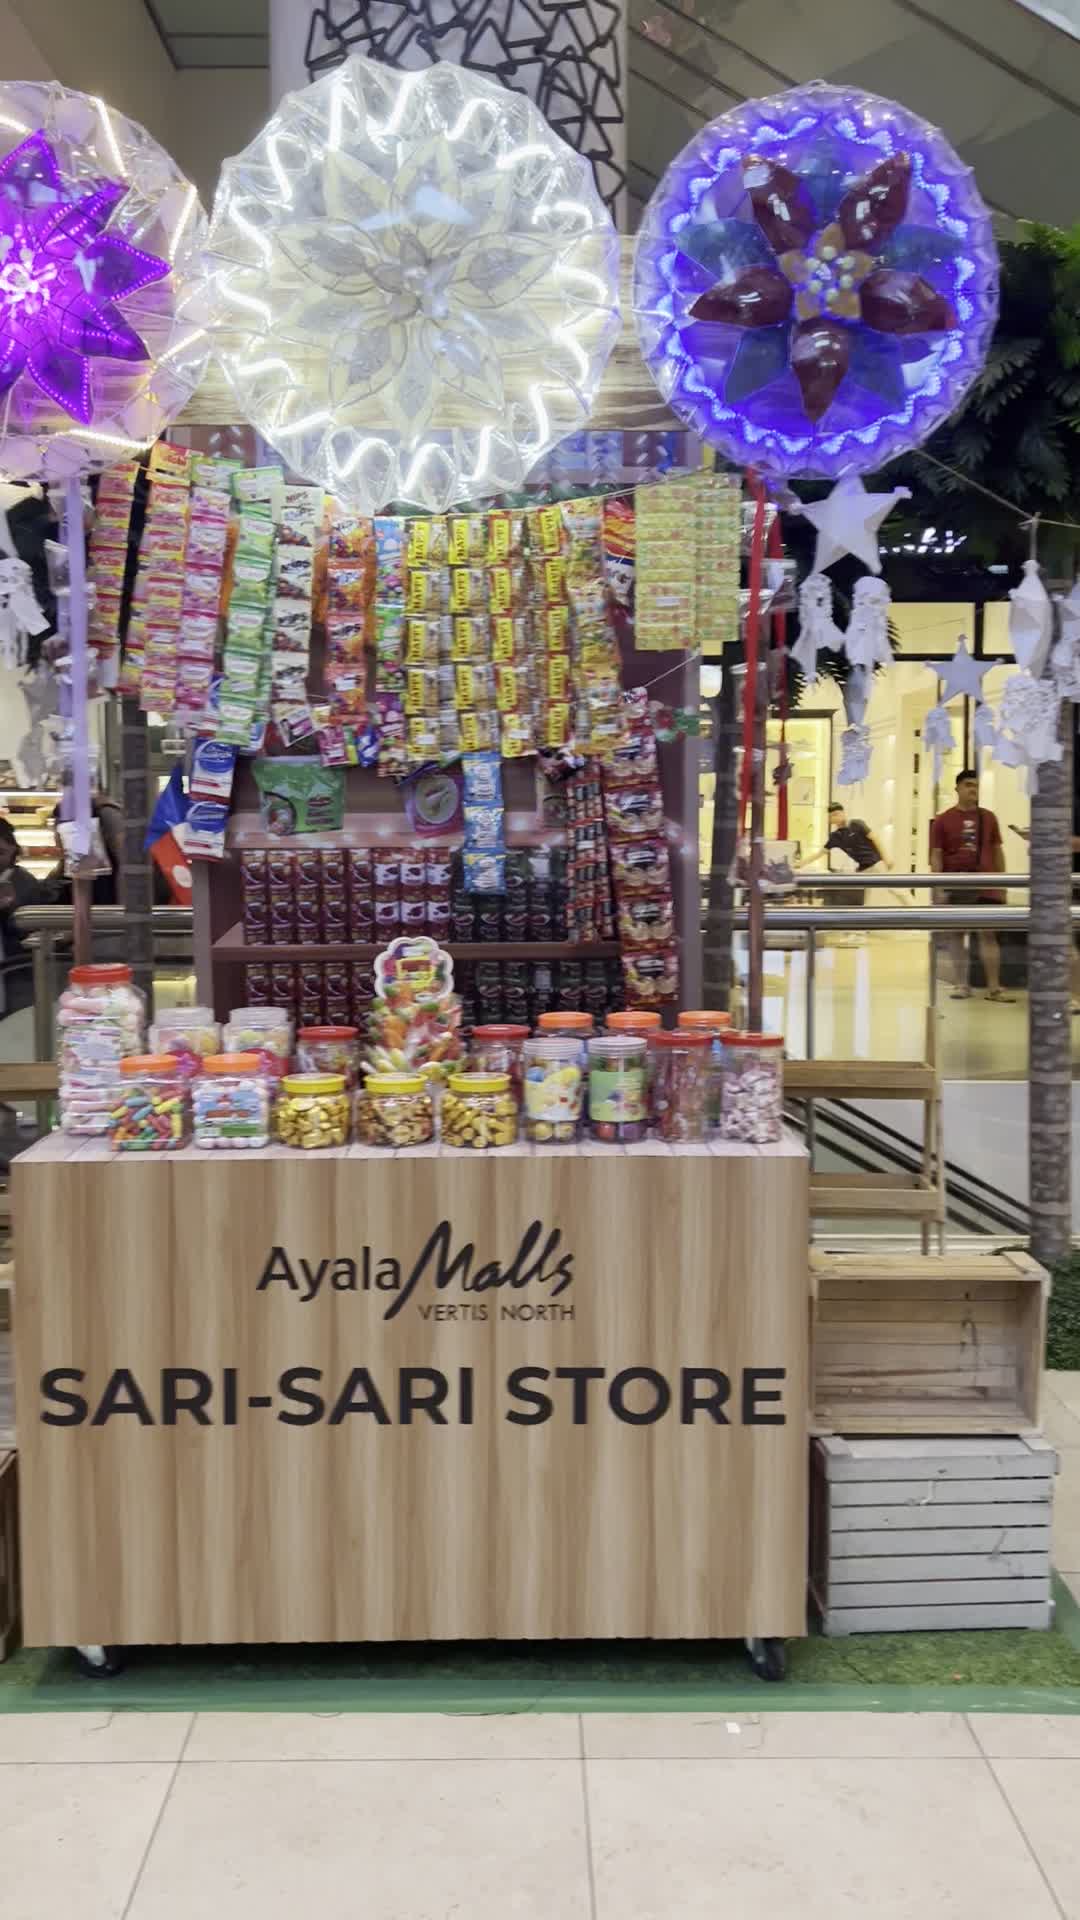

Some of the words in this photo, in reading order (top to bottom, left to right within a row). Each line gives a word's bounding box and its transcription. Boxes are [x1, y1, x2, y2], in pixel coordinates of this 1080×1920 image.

[456, 571, 466, 607] HAPPY
[255, 1246, 402, 1302] Ayala
[383, 1220, 575, 1320] Malls
[418, 1304, 489, 1321] VERTIS
[501, 1304, 576, 1321] NORTH
[40, 1366, 473, 1426] SARI-SARI
[506, 1366, 786, 1426] STORE
